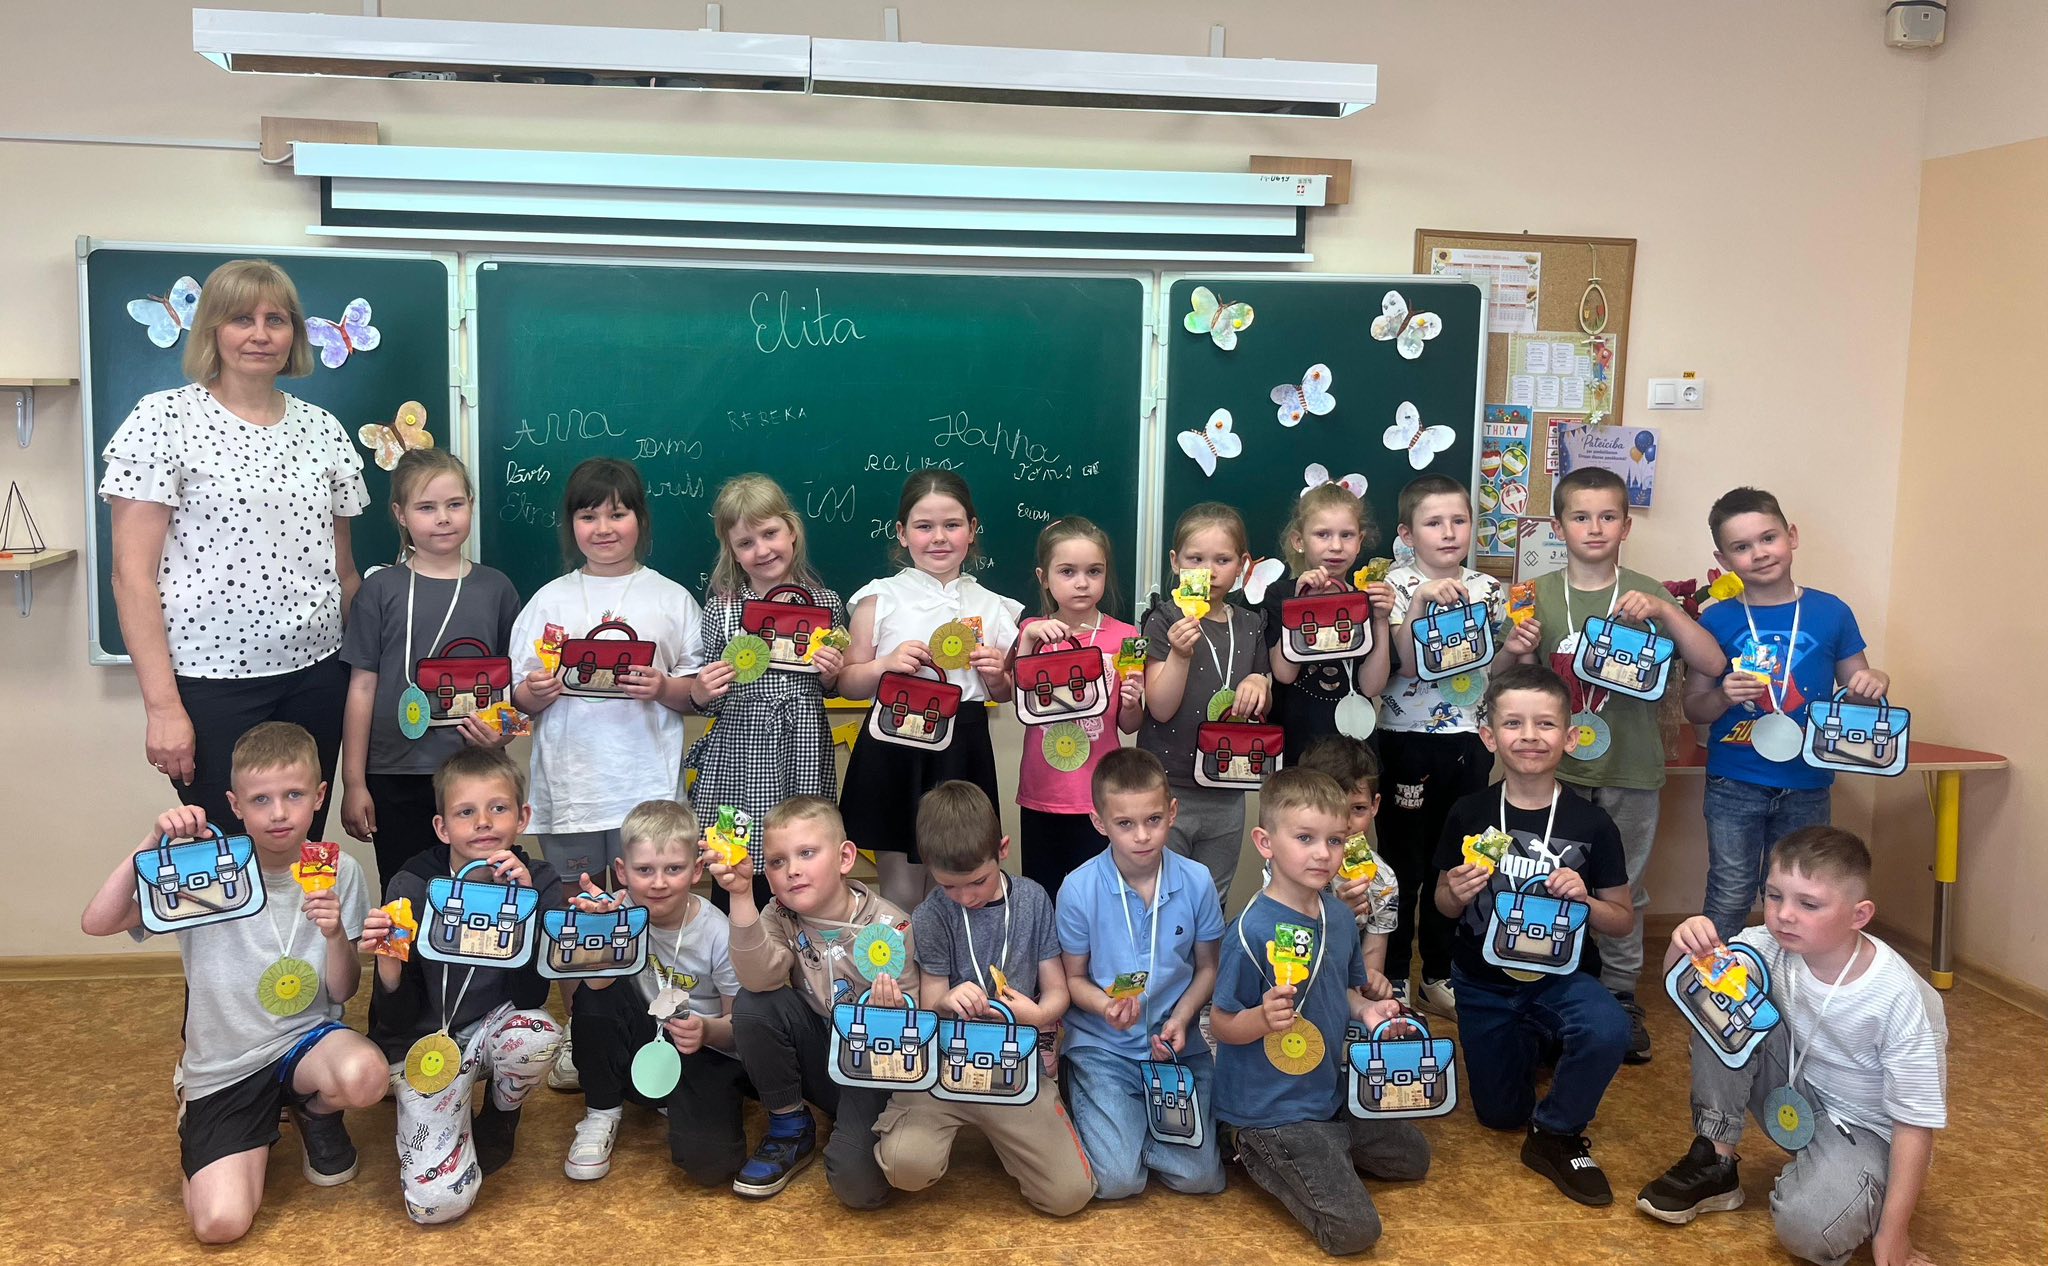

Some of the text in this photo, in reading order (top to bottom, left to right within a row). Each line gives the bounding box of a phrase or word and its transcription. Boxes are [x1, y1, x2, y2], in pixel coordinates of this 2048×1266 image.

[750, 287, 867, 354] Elita
[1485, 423, 1519, 437] THDAY
[1494, 853, 1551, 880] UMA
